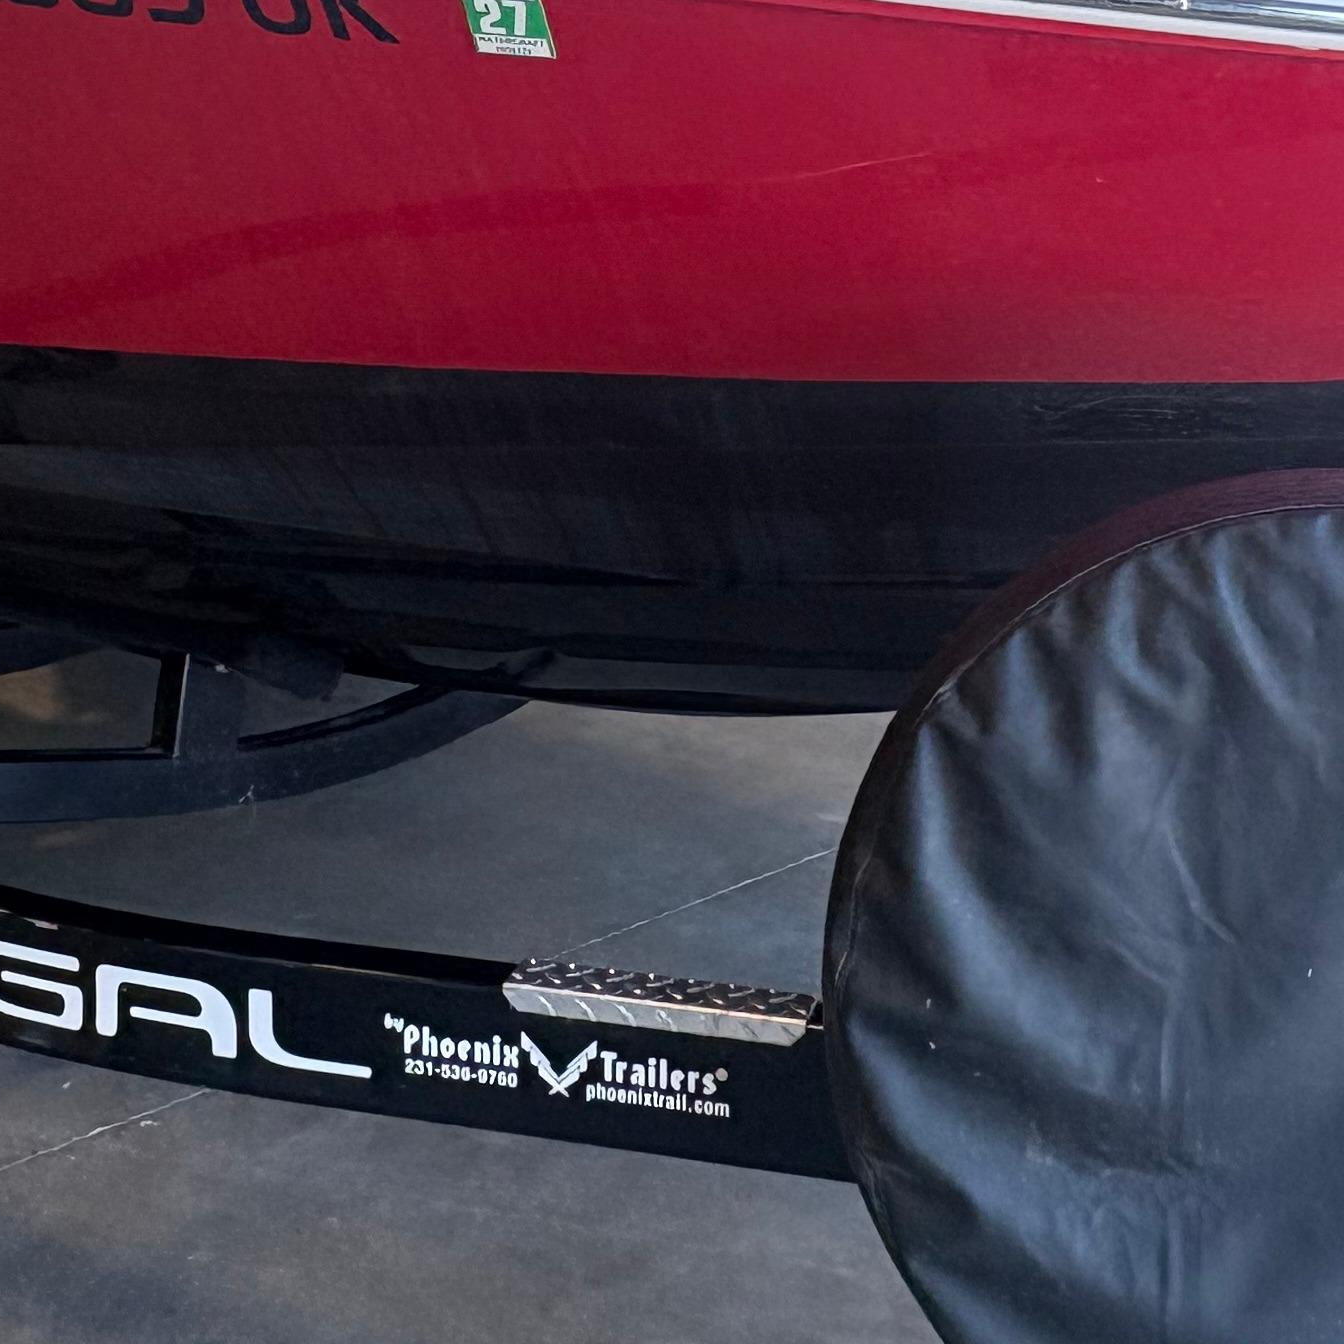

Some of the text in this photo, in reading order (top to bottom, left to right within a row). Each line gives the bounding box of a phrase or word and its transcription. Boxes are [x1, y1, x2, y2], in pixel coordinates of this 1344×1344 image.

[403, 1024, 519, 1068] Phoenix
[600, 1051, 719, 1096] Trailers
[585, 1082, 730, 1118] phoenixtrail.com
